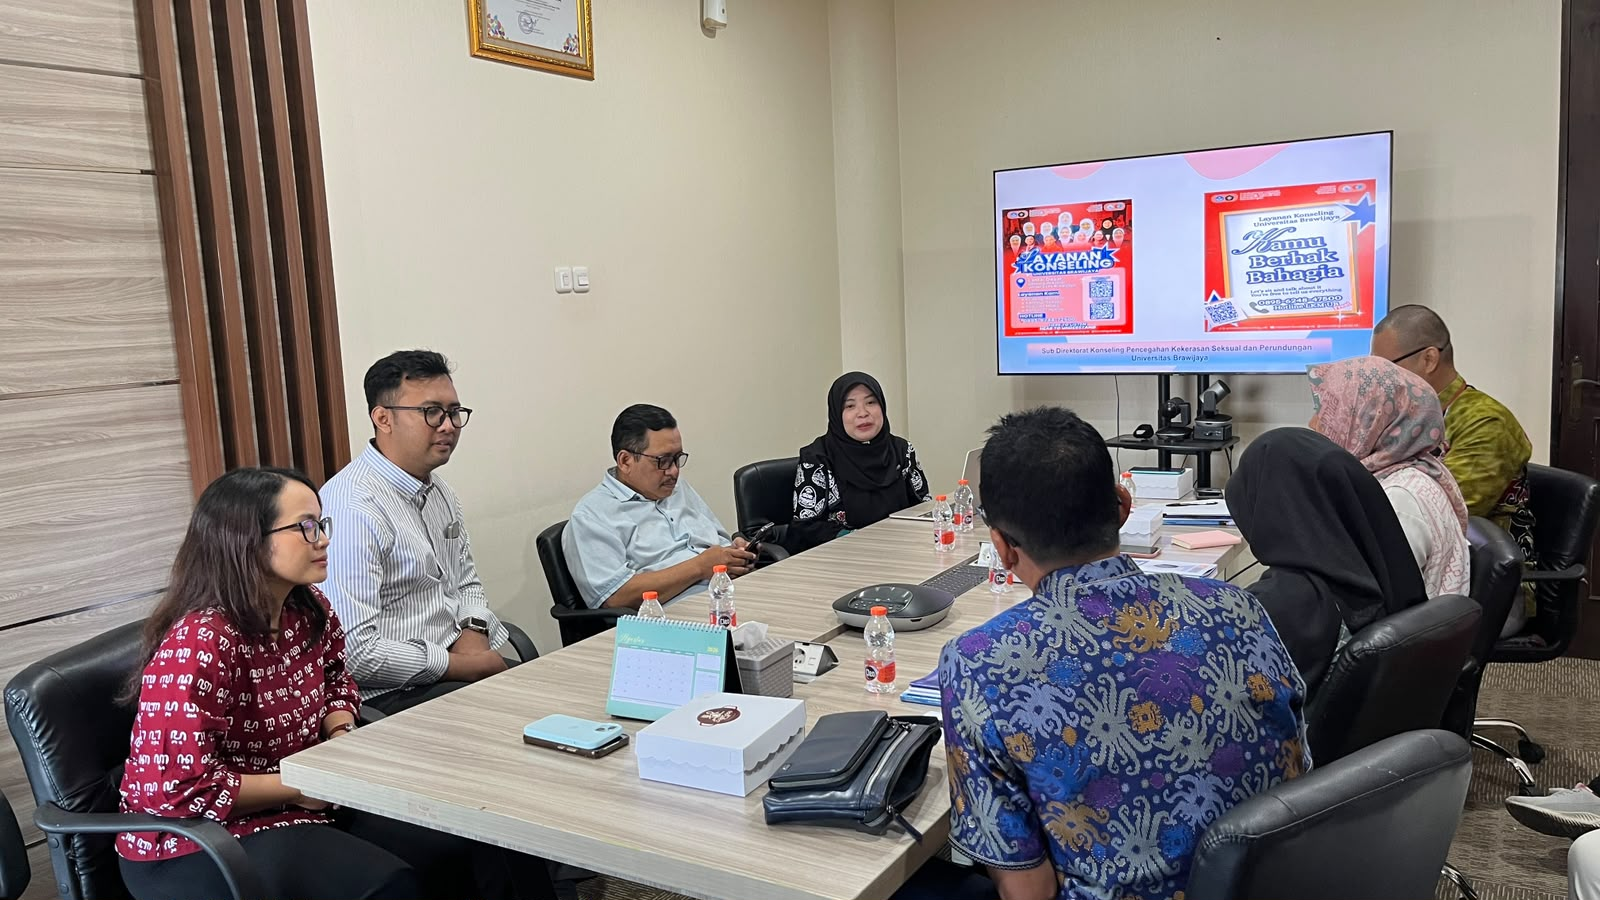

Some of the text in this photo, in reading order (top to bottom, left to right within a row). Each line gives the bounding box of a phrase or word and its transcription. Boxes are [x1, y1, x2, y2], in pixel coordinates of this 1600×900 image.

[1253, 215, 1340, 227] Universitas Brawijaya
[1258, 210, 1334, 222] Layanan Konseling
[1231, 226, 1326, 255] Kamu
[1019, 248, 1102, 264] LAYANAN
[1249, 248, 1338, 268] Berhak
[1024, 259, 1112, 272] KONSELING
[1247, 264, 1343, 284] Bahagia
[1126, 346, 1170, 354] Pencegahan
[1259, 344, 1312, 352] Perundungan
[1173, 354, 1209, 362] Brawijaya
